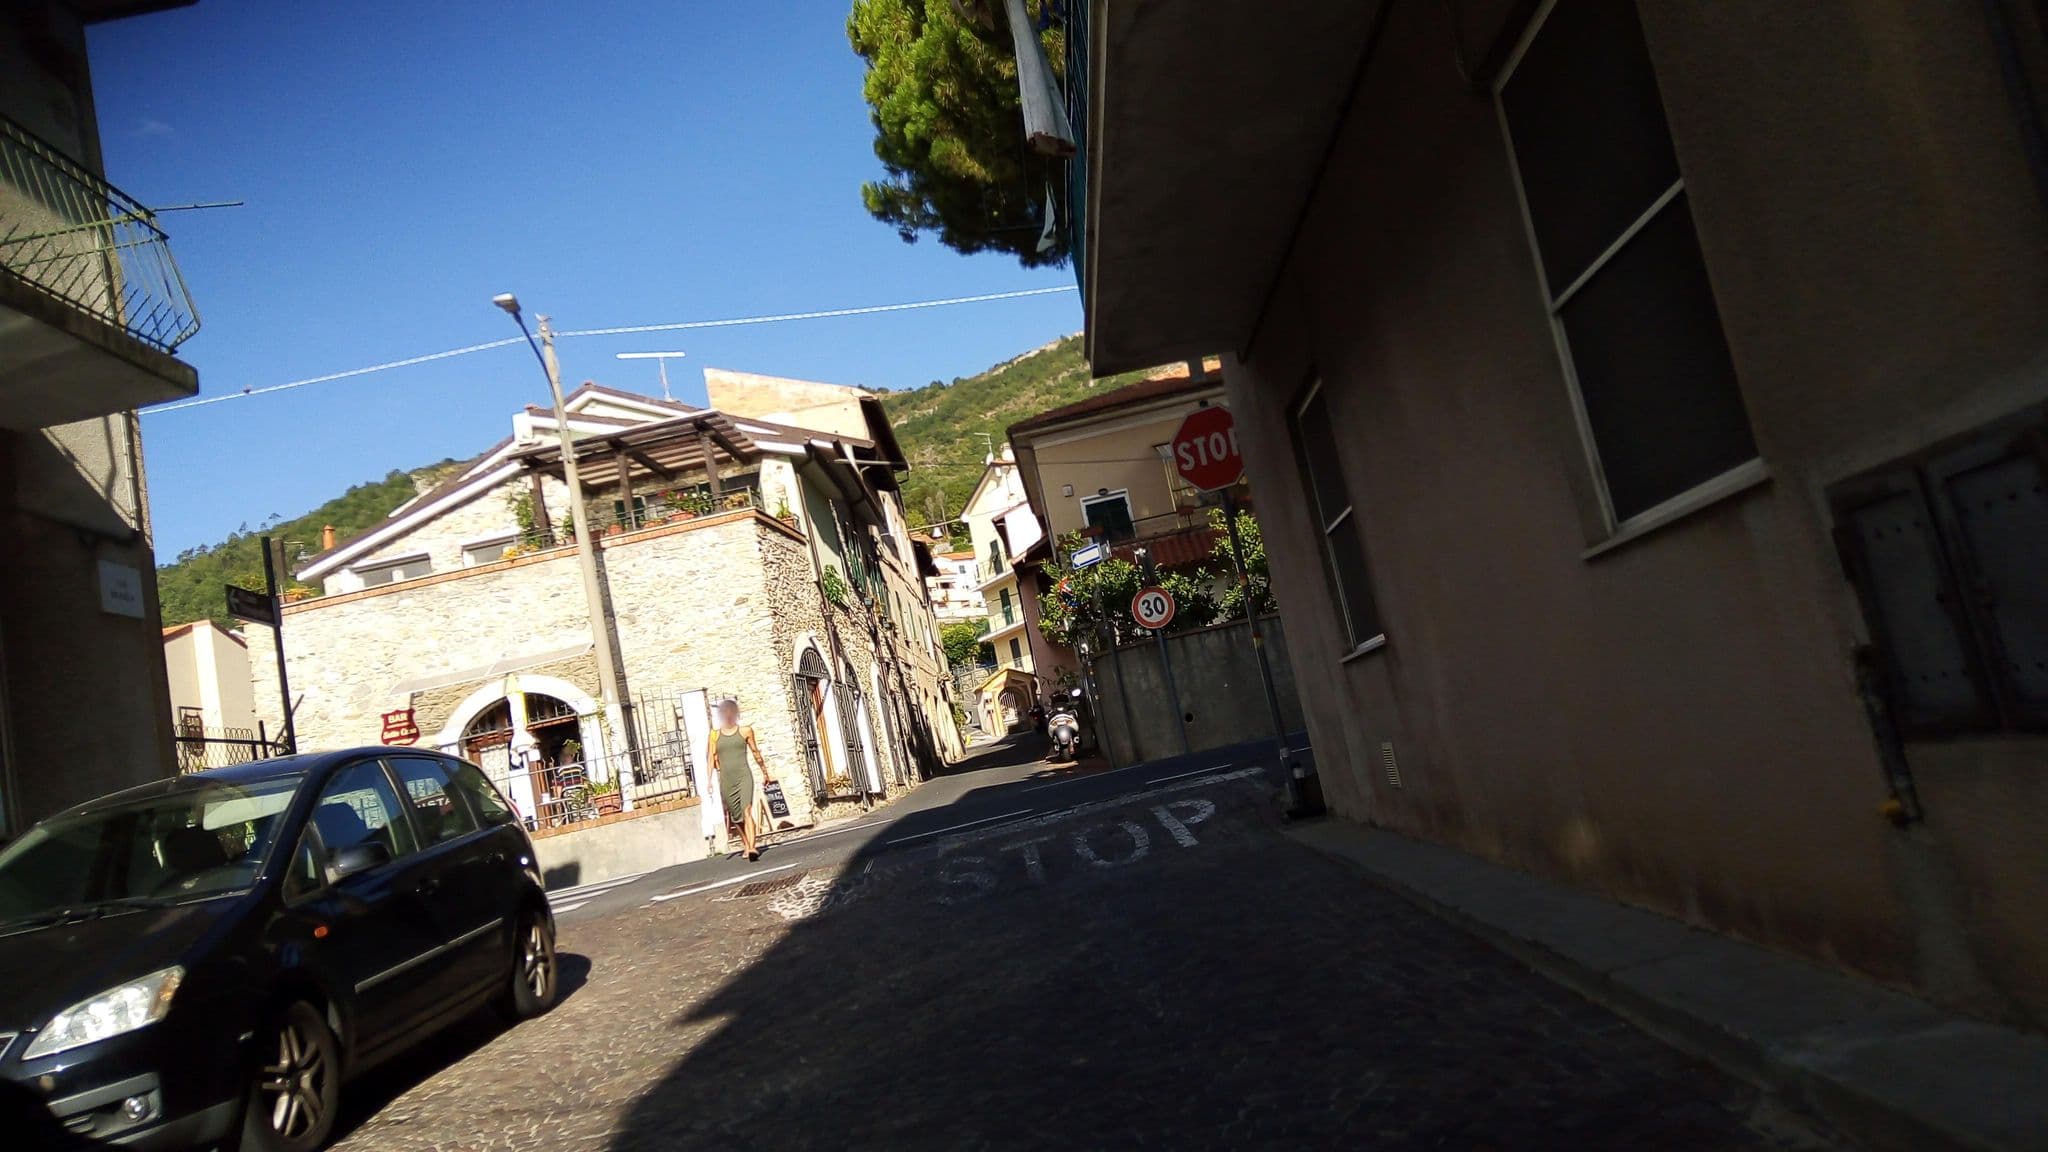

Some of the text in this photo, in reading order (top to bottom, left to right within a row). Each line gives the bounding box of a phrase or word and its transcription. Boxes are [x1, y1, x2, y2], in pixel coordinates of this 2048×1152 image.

[1141, 596, 1166, 618] 30
[387, 712, 408, 724] BAR
[936, 799, 1215, 904] STOP
